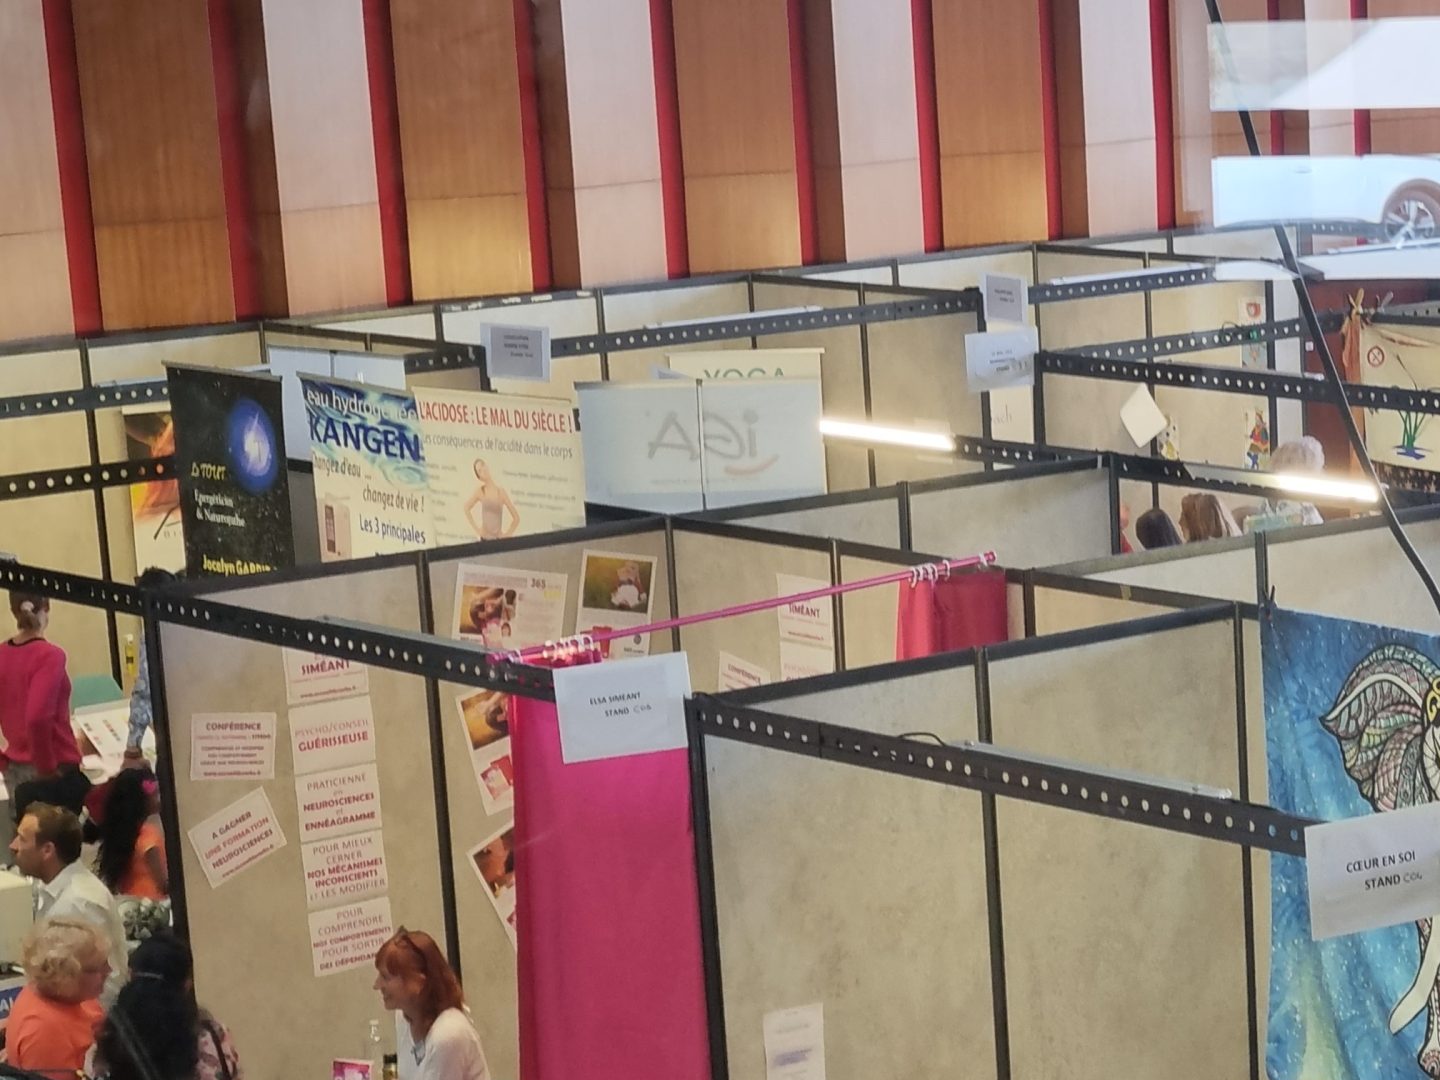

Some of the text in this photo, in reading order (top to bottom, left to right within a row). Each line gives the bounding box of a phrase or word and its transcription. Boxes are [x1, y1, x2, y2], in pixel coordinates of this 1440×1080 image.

[307, 387, 329, 406] eau
[418, 401, 567, 433] L'ACIDOSE LE MAL DU SIÈCLE
[309, 411, 421, 463] KANGEN
[550, 446, 573, 460] corps
[313, 452, 339, 478] hangez
[363, 484, 419, 512] changez de vie
[360, 513, 426, 544] Les 3 principales
[298, 731, 369, 752] GUÉRISSEUSE
[303, 792, 375, 812] NEUROSCIENCES
[305, 811, 376, 831] ENNÉAGRAMME
[1346, 850, 1416, 873] CŒUR EN SOI
[1365, 874, 1401, 890] STAND
